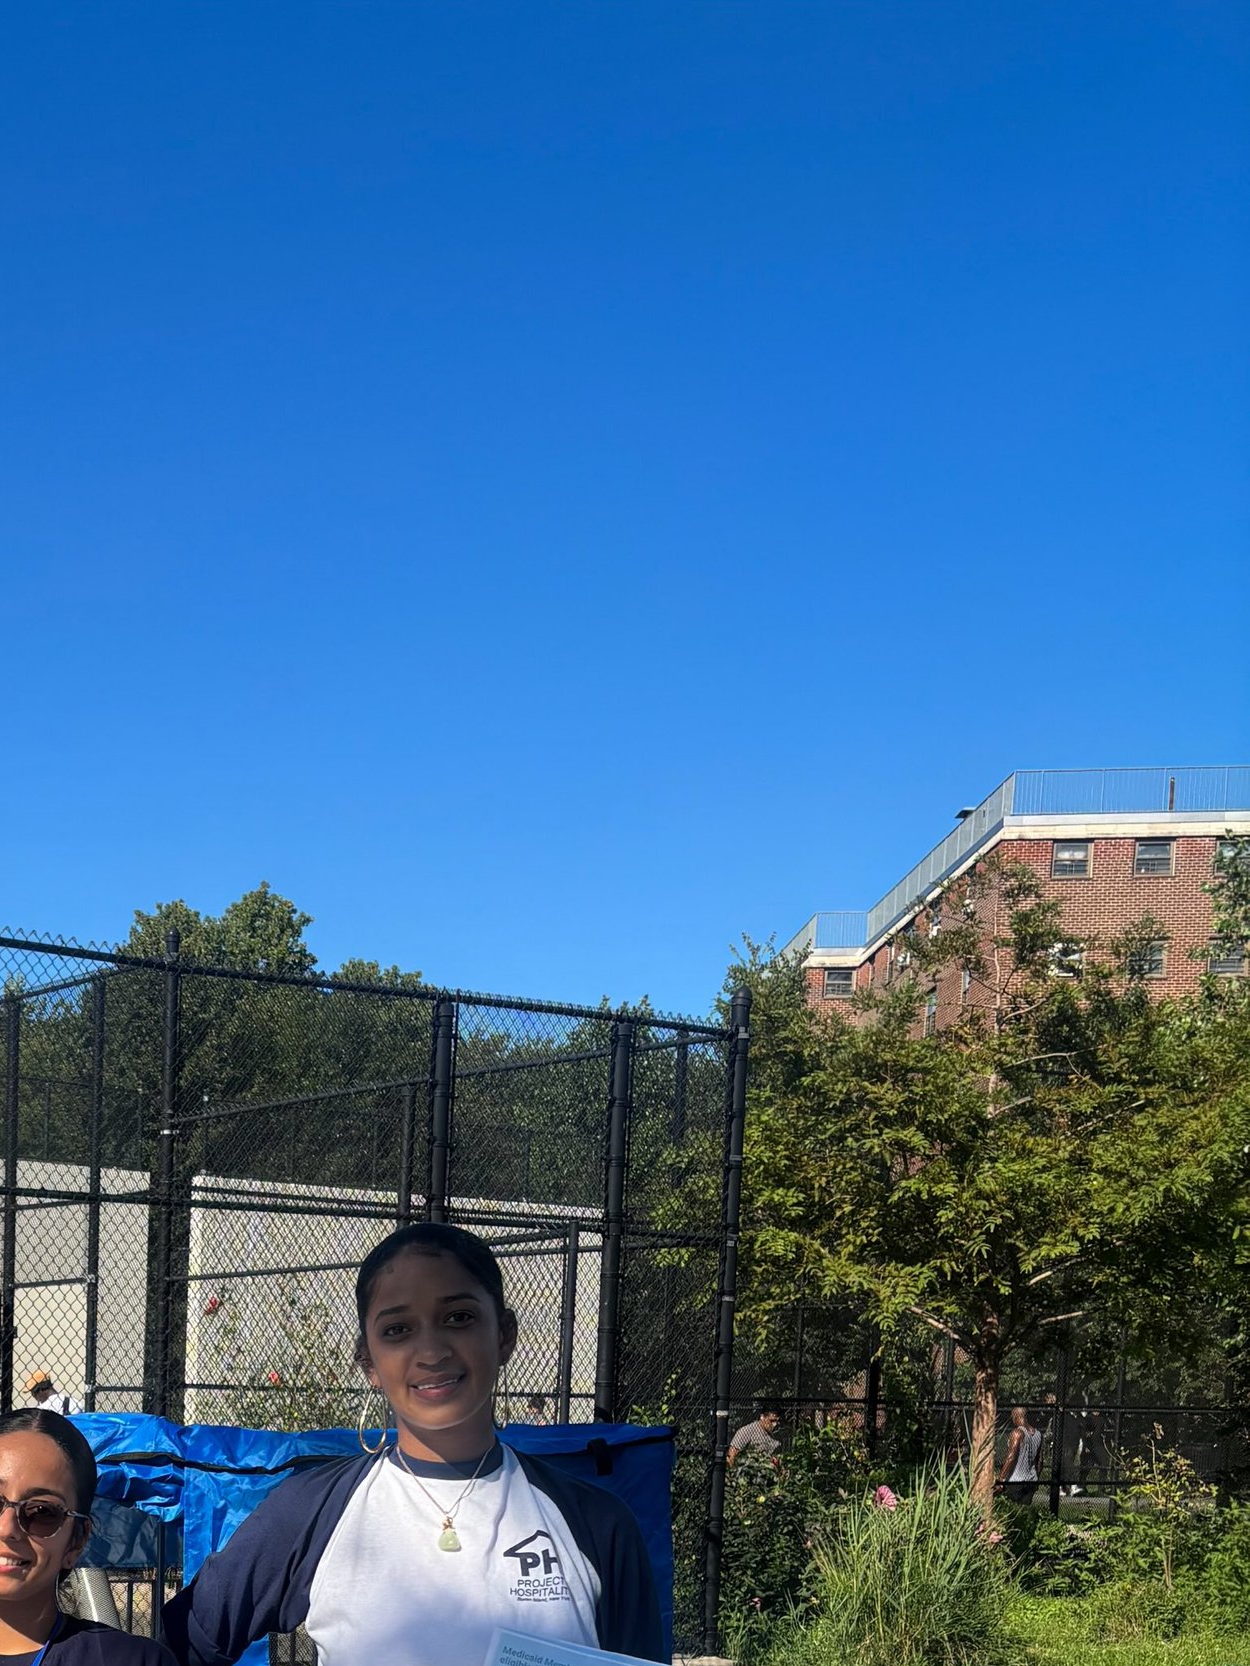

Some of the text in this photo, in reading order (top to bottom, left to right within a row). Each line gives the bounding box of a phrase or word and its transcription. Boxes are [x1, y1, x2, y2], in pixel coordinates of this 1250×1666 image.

[517, 1576, 564, 1588] PROJECT
[510, 1587, 569, 1597] HOSPITALIT
[503, 1646, 543, 1664] Medicaid
